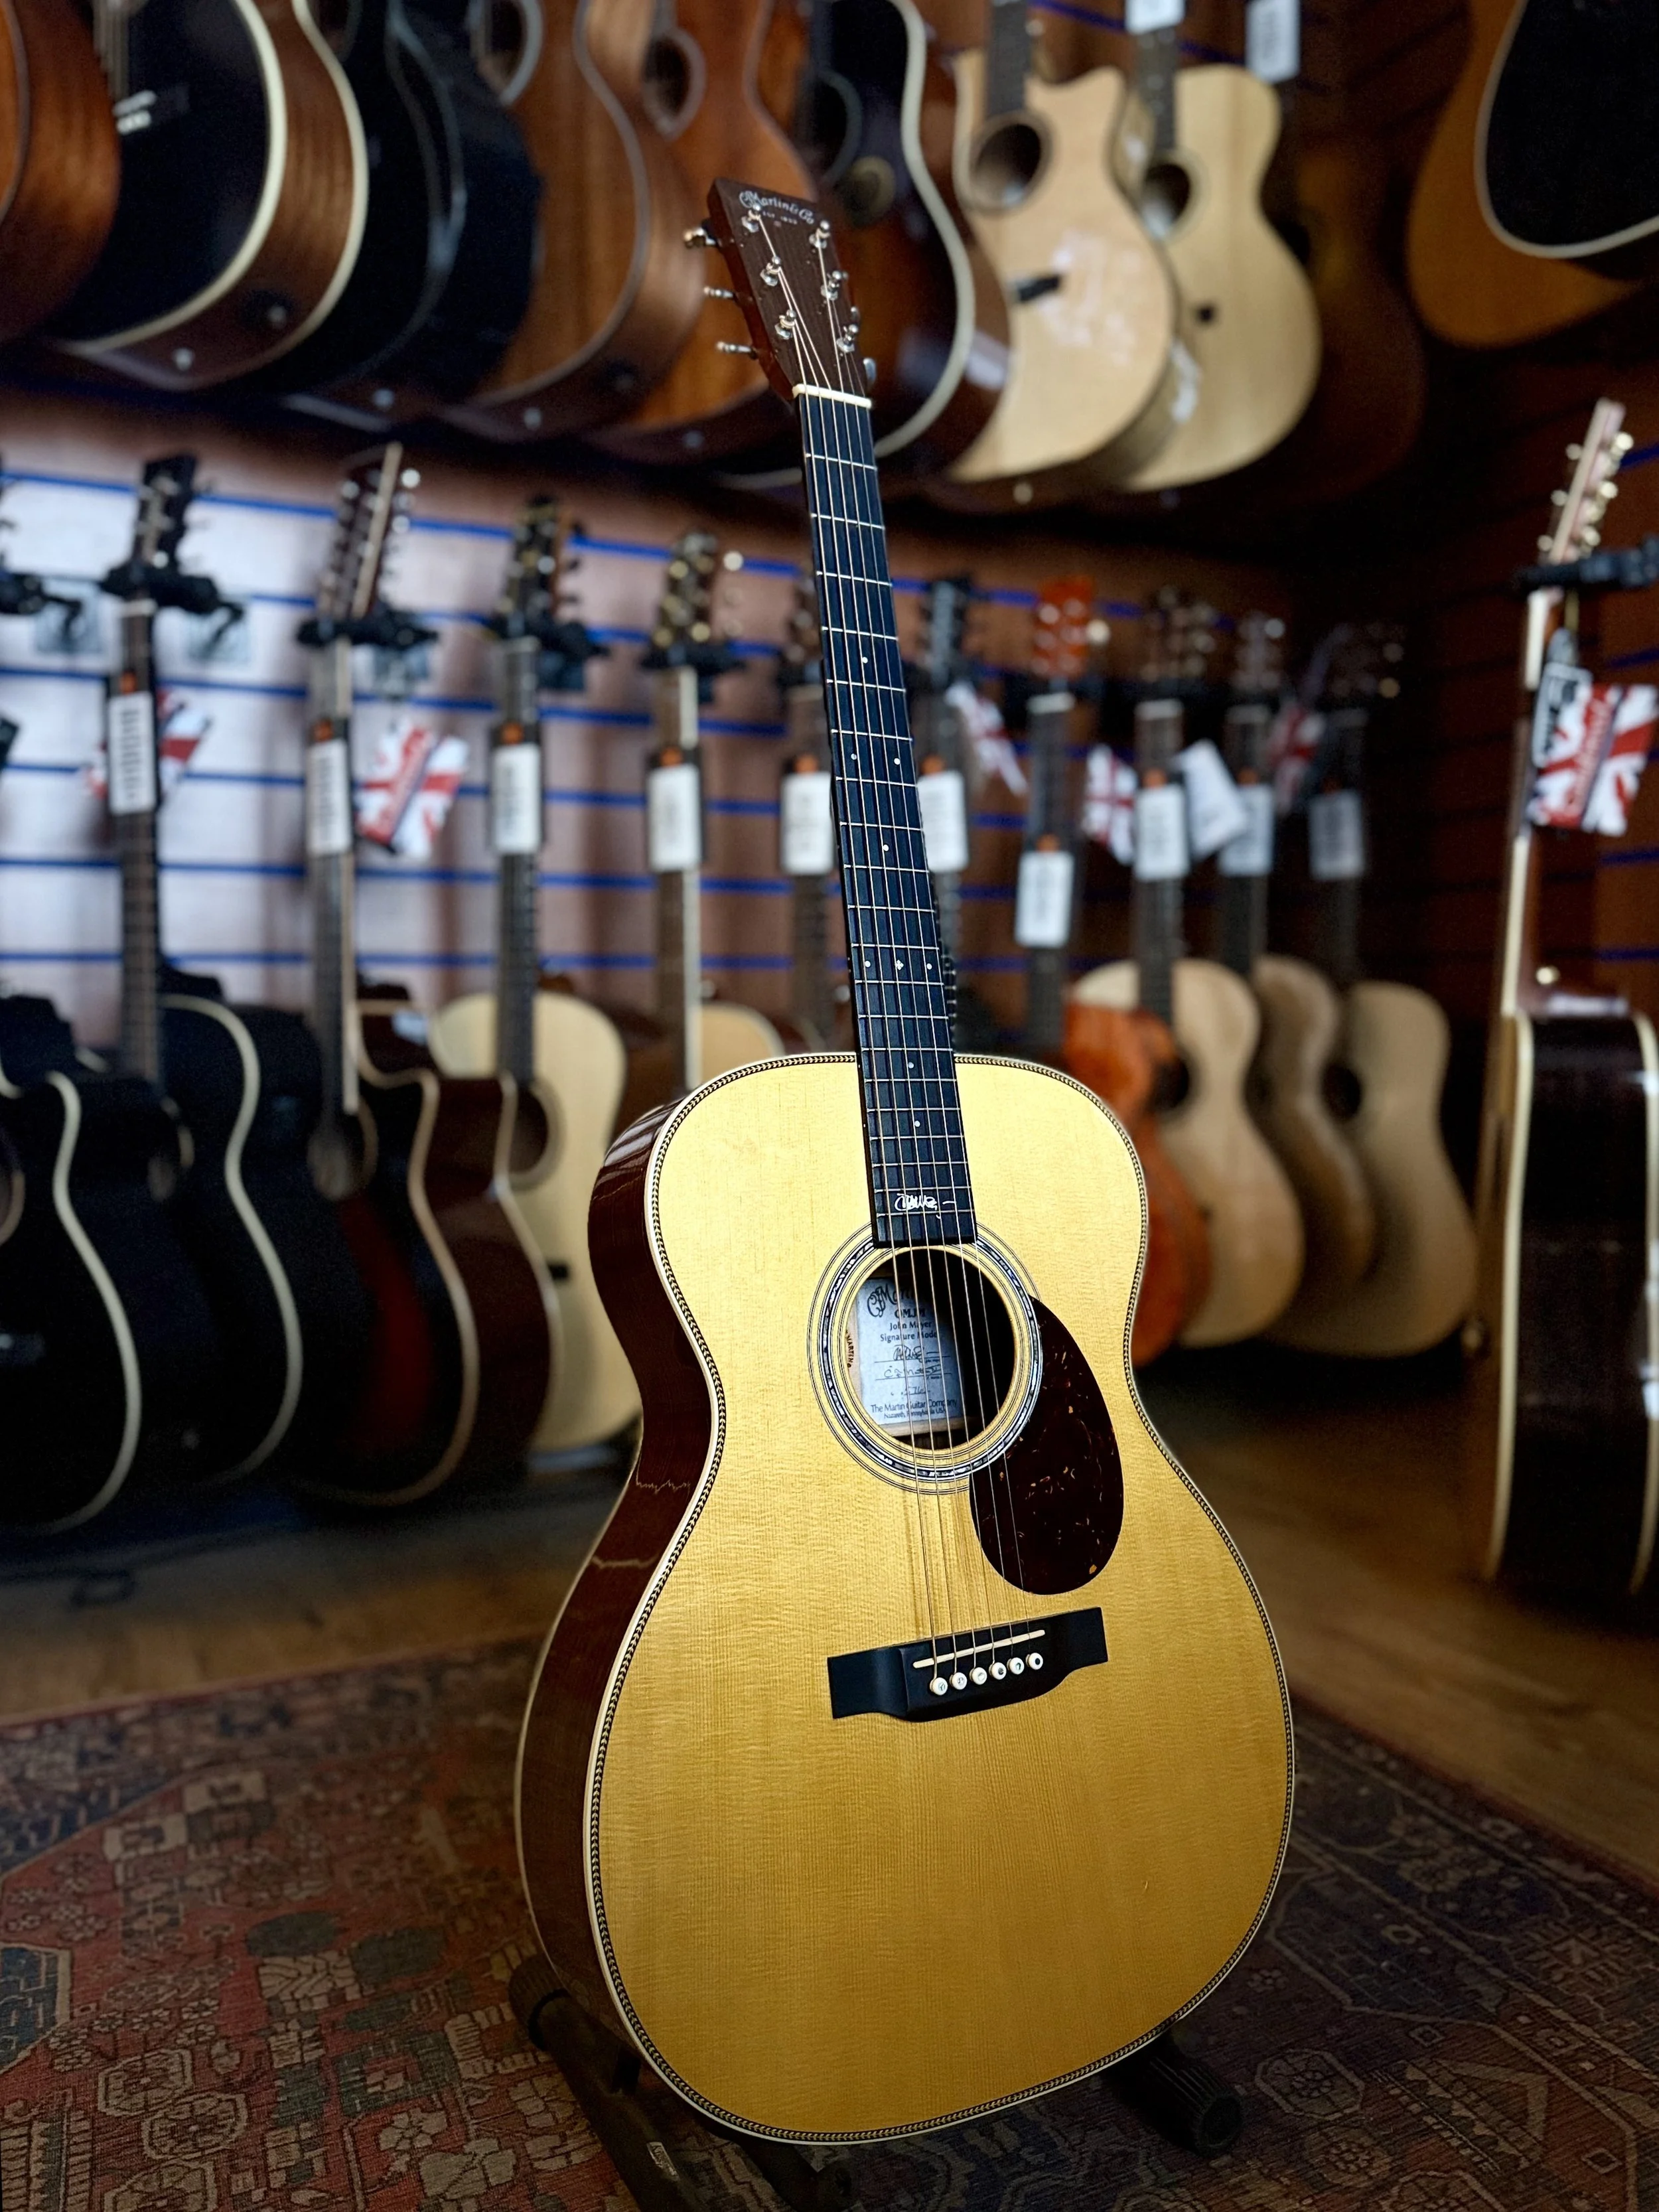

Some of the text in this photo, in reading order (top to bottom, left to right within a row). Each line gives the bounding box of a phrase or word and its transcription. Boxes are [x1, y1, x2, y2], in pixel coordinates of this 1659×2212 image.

[910, 1321, 932, 1330] Myer
[881, 1333, 914, 1343] Signaure
[871, 1404, 883, 1412] The
[885, 1402, 904, 1412] Martin
[906, 1401, 926, 1410] Guitar
